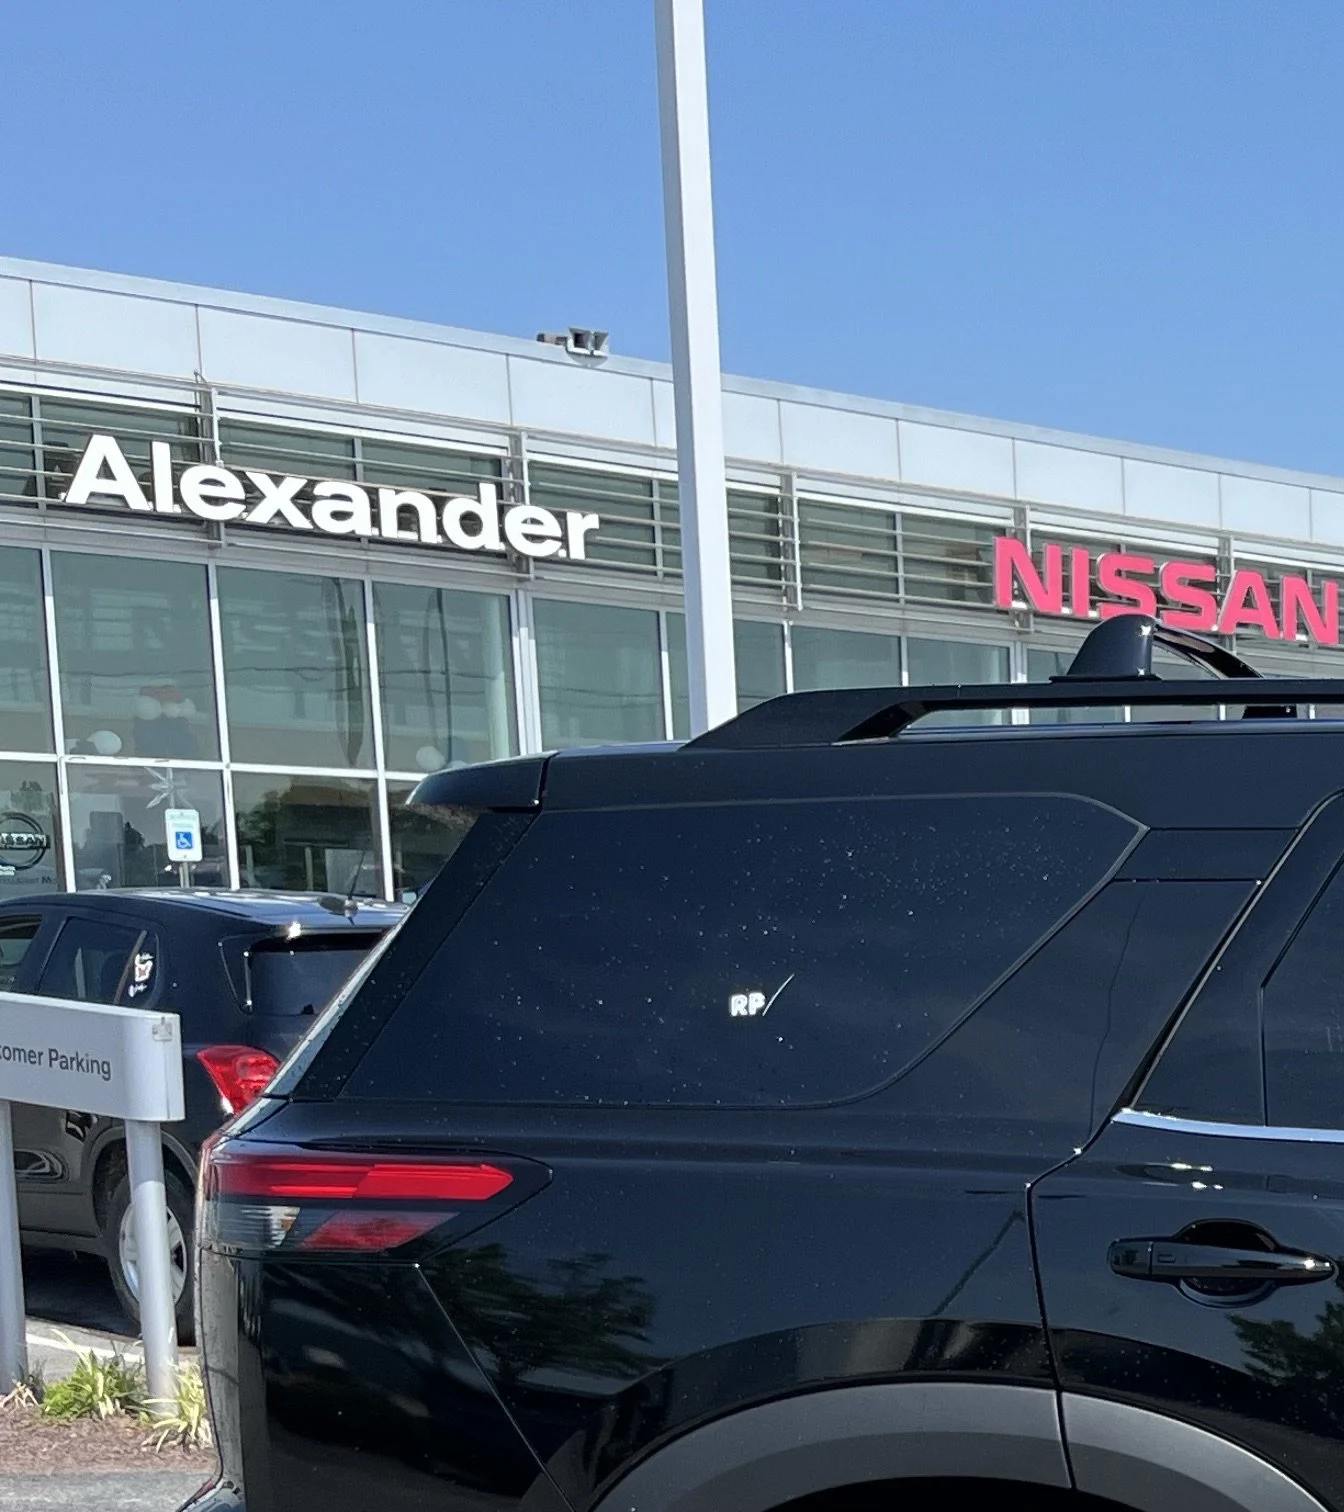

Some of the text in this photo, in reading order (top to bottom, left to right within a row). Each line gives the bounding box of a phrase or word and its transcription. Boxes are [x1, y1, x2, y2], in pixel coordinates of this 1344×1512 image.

[63, 434, 600, 560] Alexander
[993, 535, 1340, 646] NISSAN
[0, 834, 46, 848] ISSAN
[0, 1045, 112, 1082] omer Parking
